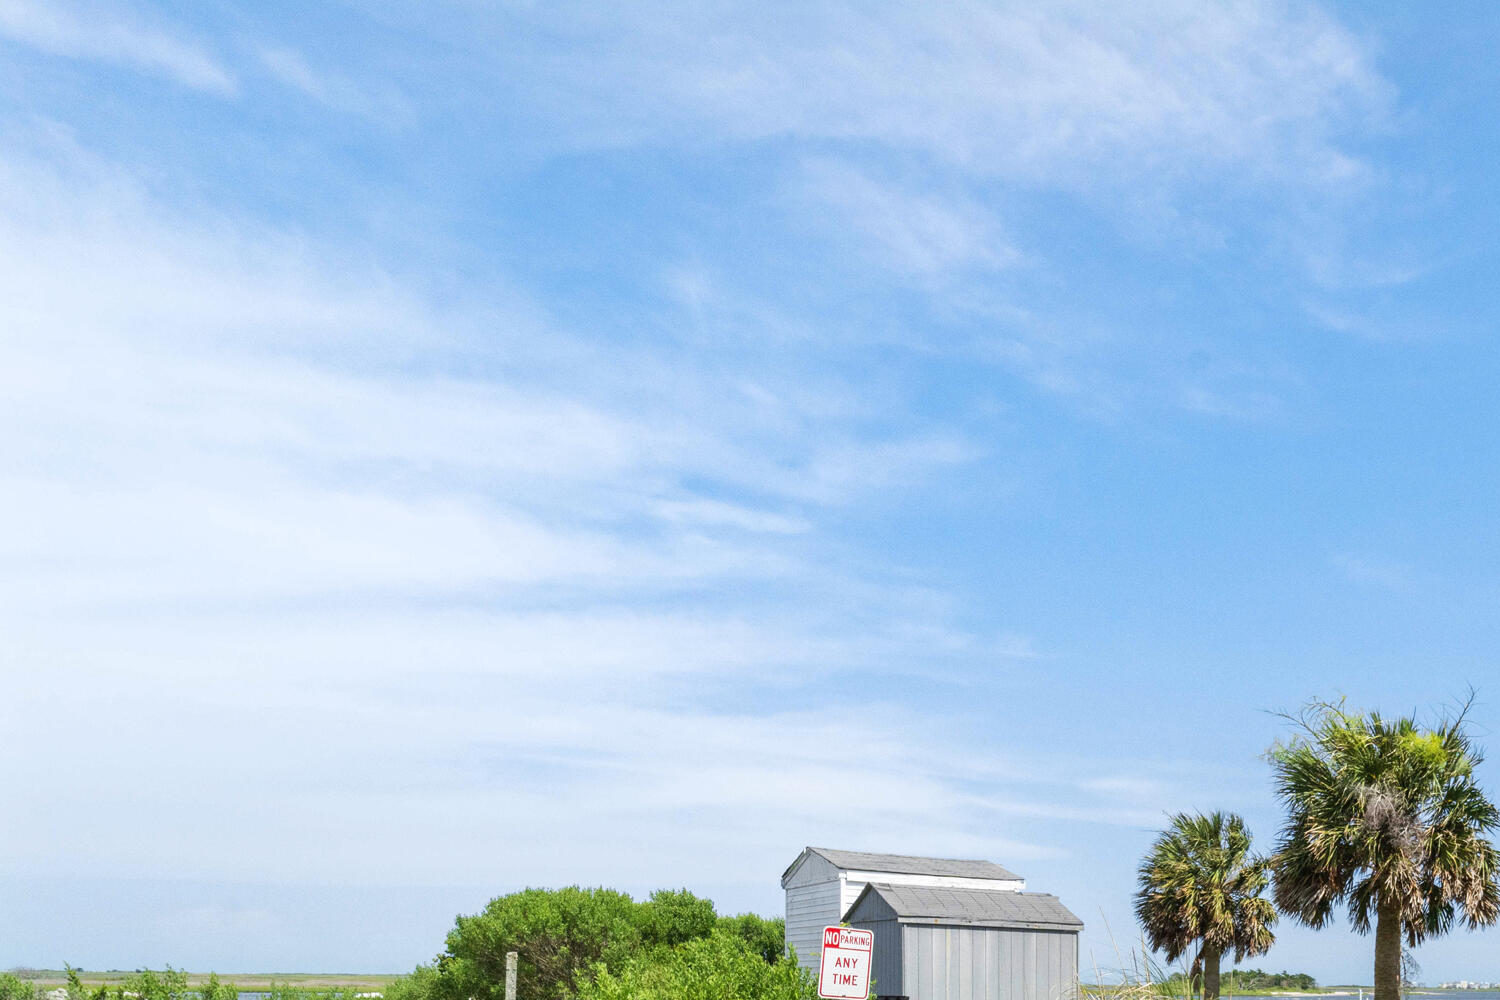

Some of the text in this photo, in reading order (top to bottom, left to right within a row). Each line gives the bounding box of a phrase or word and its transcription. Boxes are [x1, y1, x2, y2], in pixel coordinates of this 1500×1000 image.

[825, 931, 870, 946] NO PARKING
[835, 956, 858, 969] ANY
[833, 973, 858, 986] TIME
